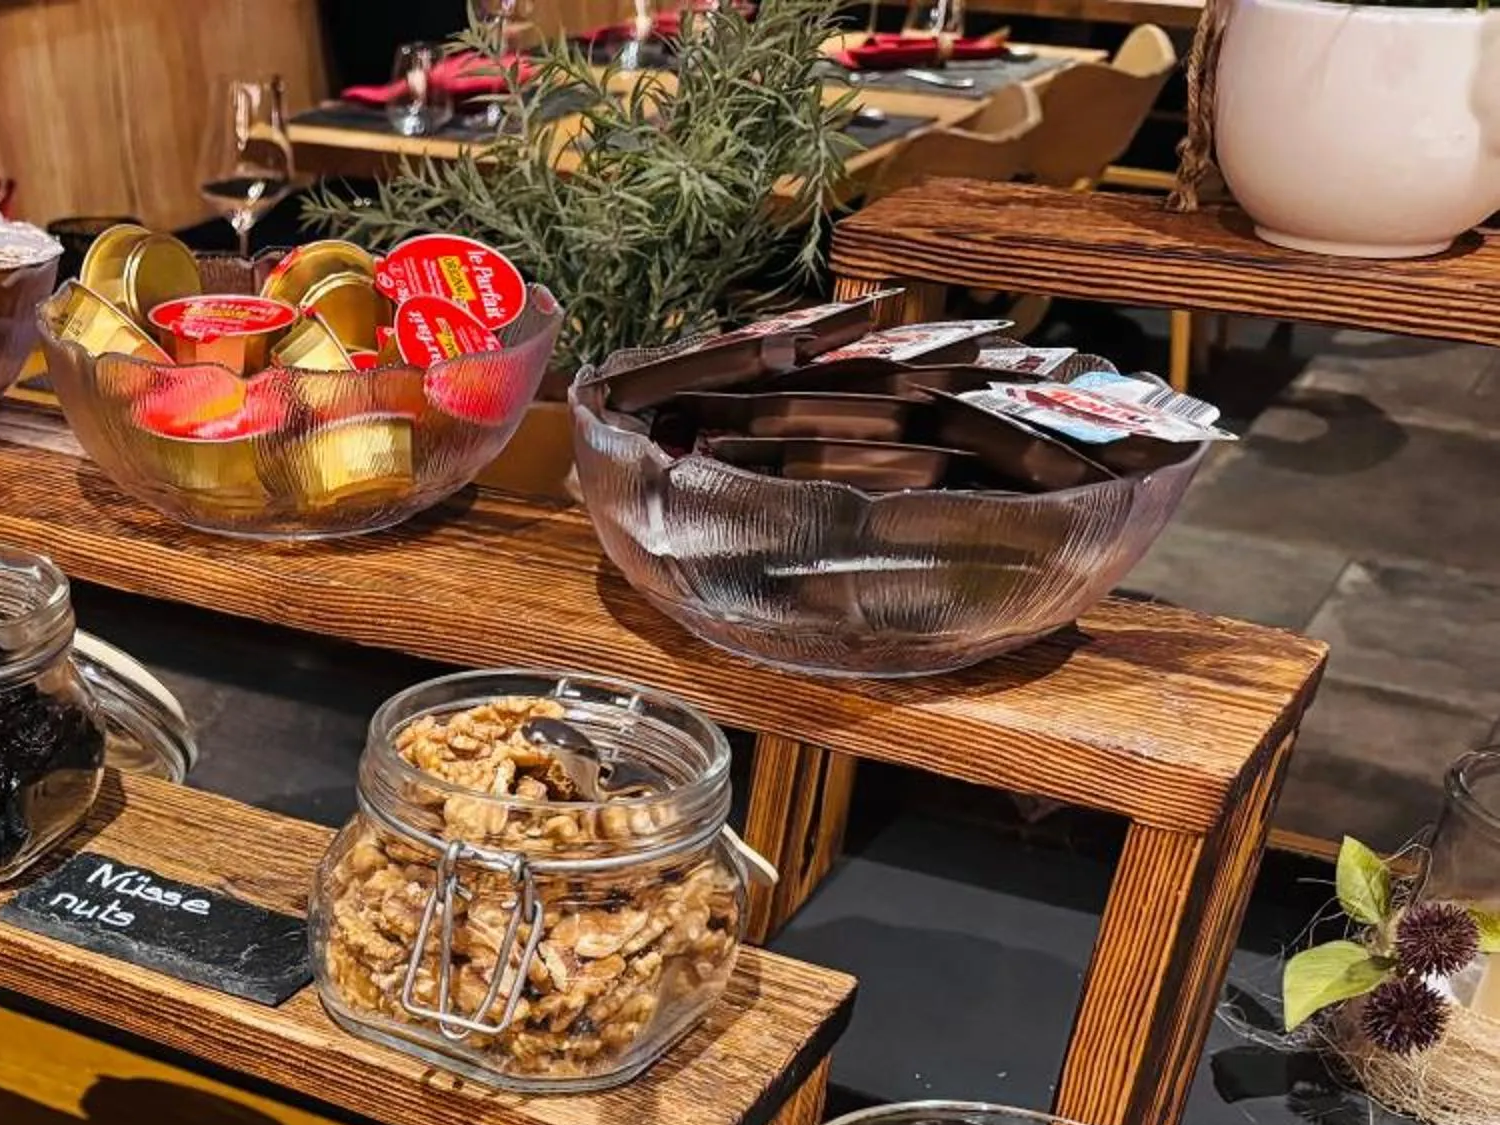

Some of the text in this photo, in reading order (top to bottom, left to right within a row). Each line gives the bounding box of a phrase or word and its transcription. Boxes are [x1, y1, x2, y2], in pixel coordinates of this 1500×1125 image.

[473, 265, 507, 320] Parfait
[49, 892, 136, 927] nuts
[86, 863, 212, 916] Nüsse
